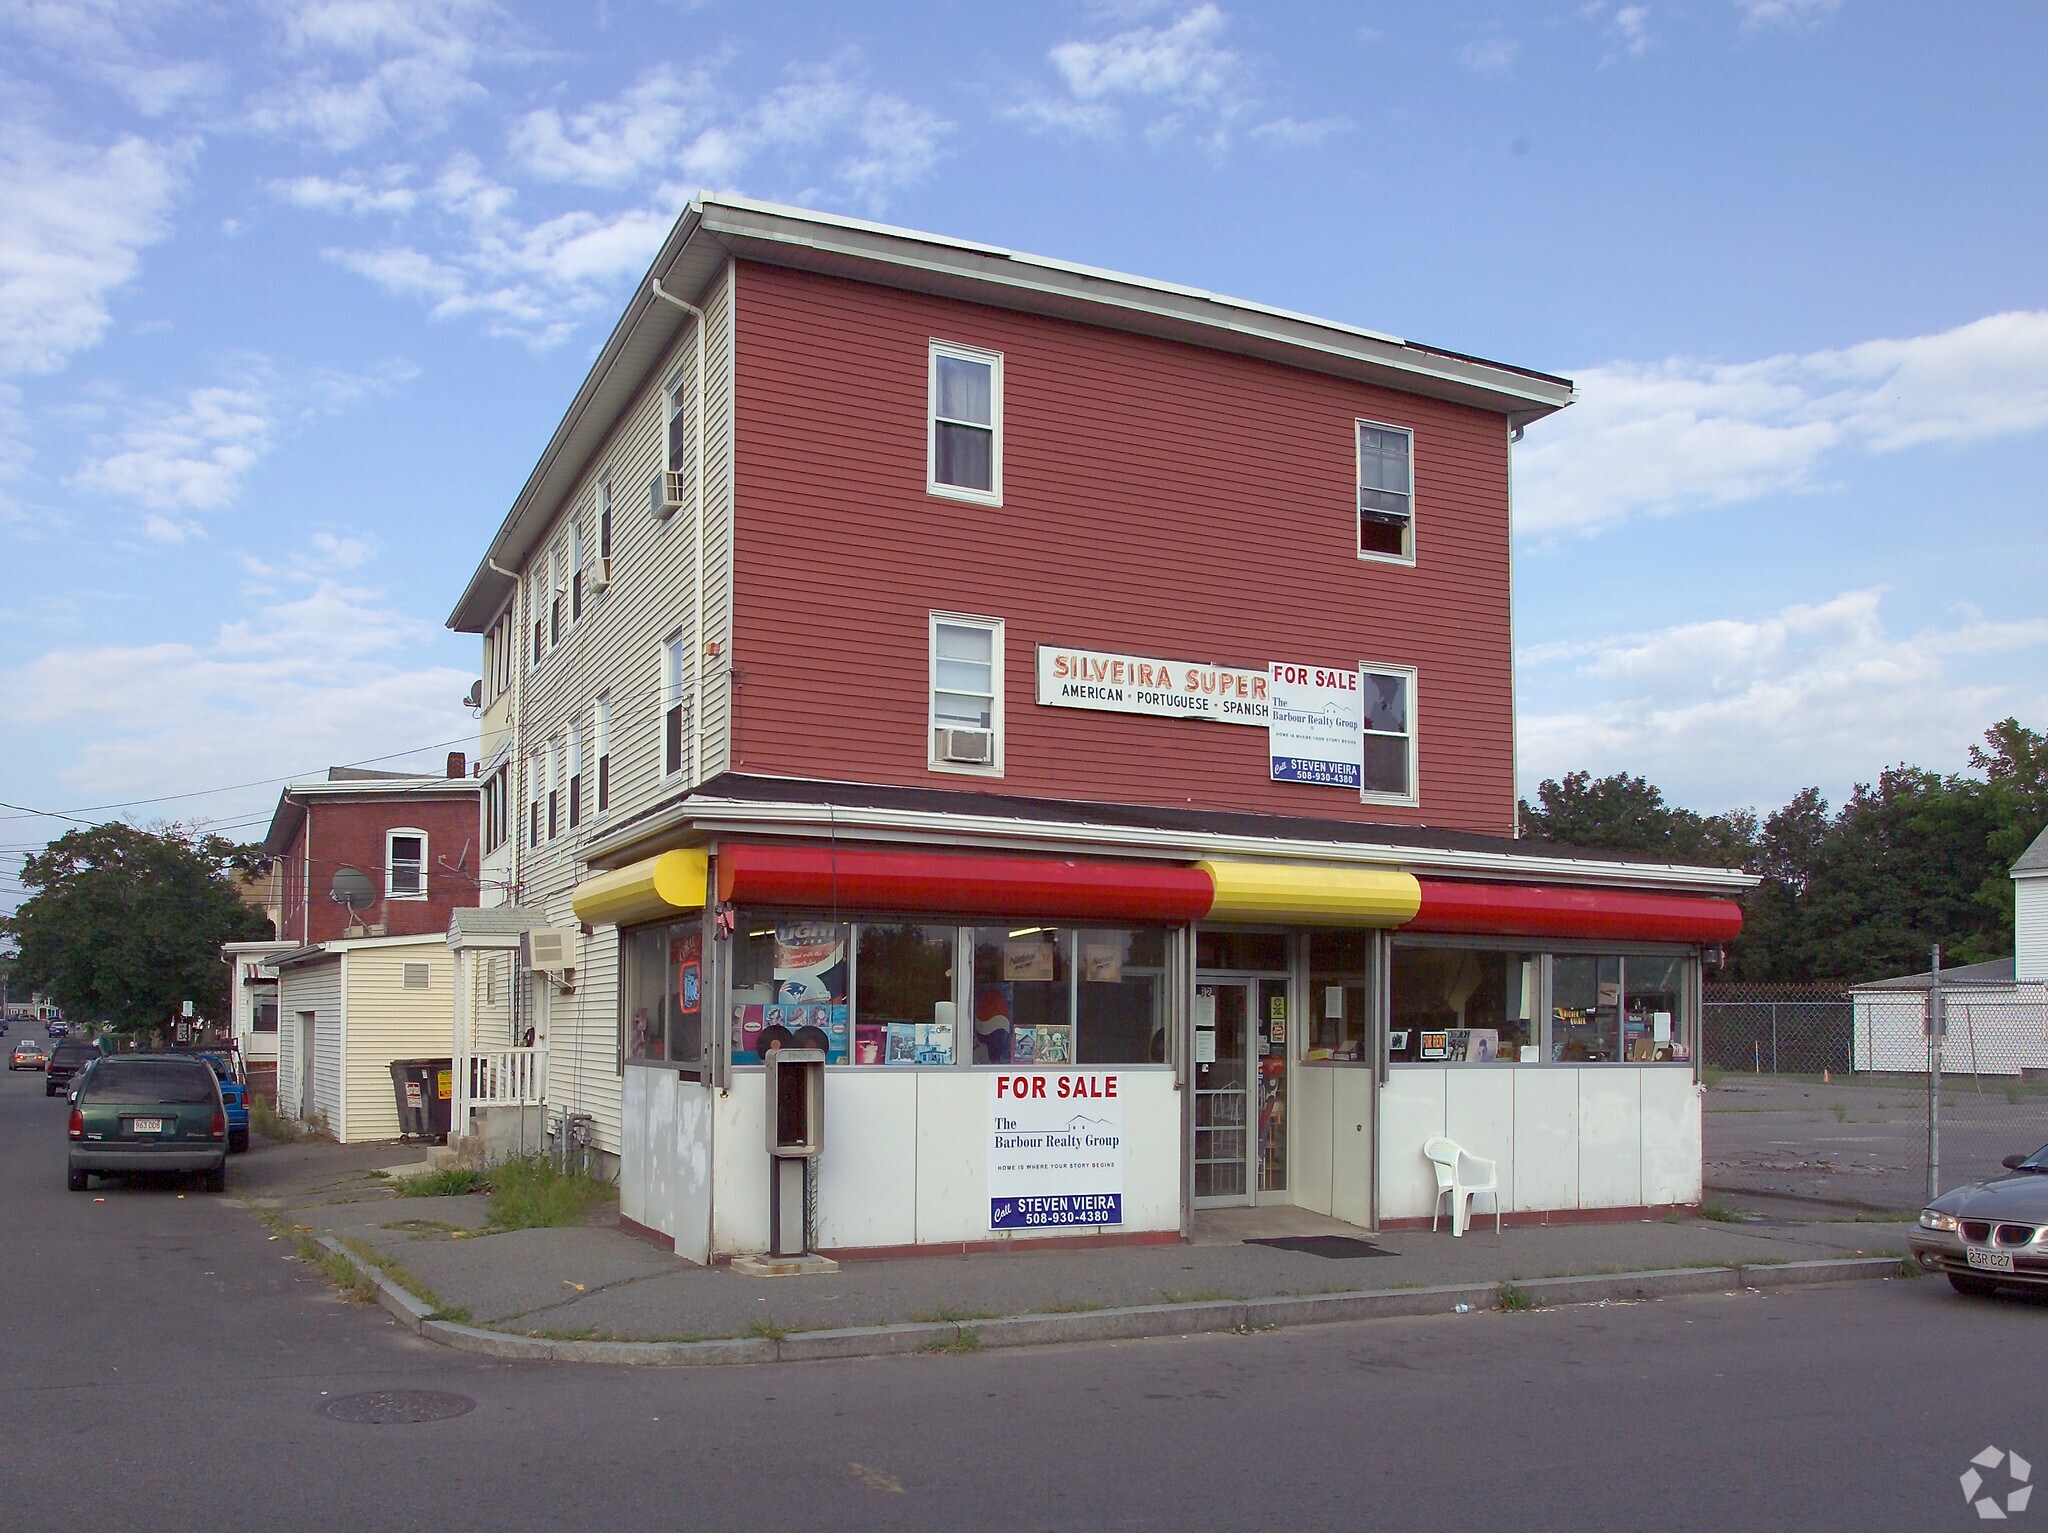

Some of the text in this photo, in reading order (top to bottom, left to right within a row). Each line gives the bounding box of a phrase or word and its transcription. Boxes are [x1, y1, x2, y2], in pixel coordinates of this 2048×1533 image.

[1053, 654, 1268, 701] SILVEIRA SUPER
[1274, 665, 1357, 691] FOR SALE
[1062, 683, 1269, 717] AMERICAN PORTUGUESE SPANISH
[1272, 696, 1288, 708] The
[1272, 710, 1358, 731] Barbour Realty Group
[1274, 760, 1288, 775] Call
[1290, 759, 1358, 776] STEVEN VIEIRA
[1297, 770, 1353, 784] 508-930-4380
[997, 1076, 1118, 1099] FOR SALE
[994, 1117, 1017, 1130] The
[994, 1134, 1120, 1150] Barbour Realty Group
[1018, 1195, 1116, 1213] STEVEN VIEIRA
[994, 1203, 1012, 1223] Call
[1026, 1211, 1109, 1225] 508-930-4380
[1968, 1252, 2010, 1267] 23R C27
